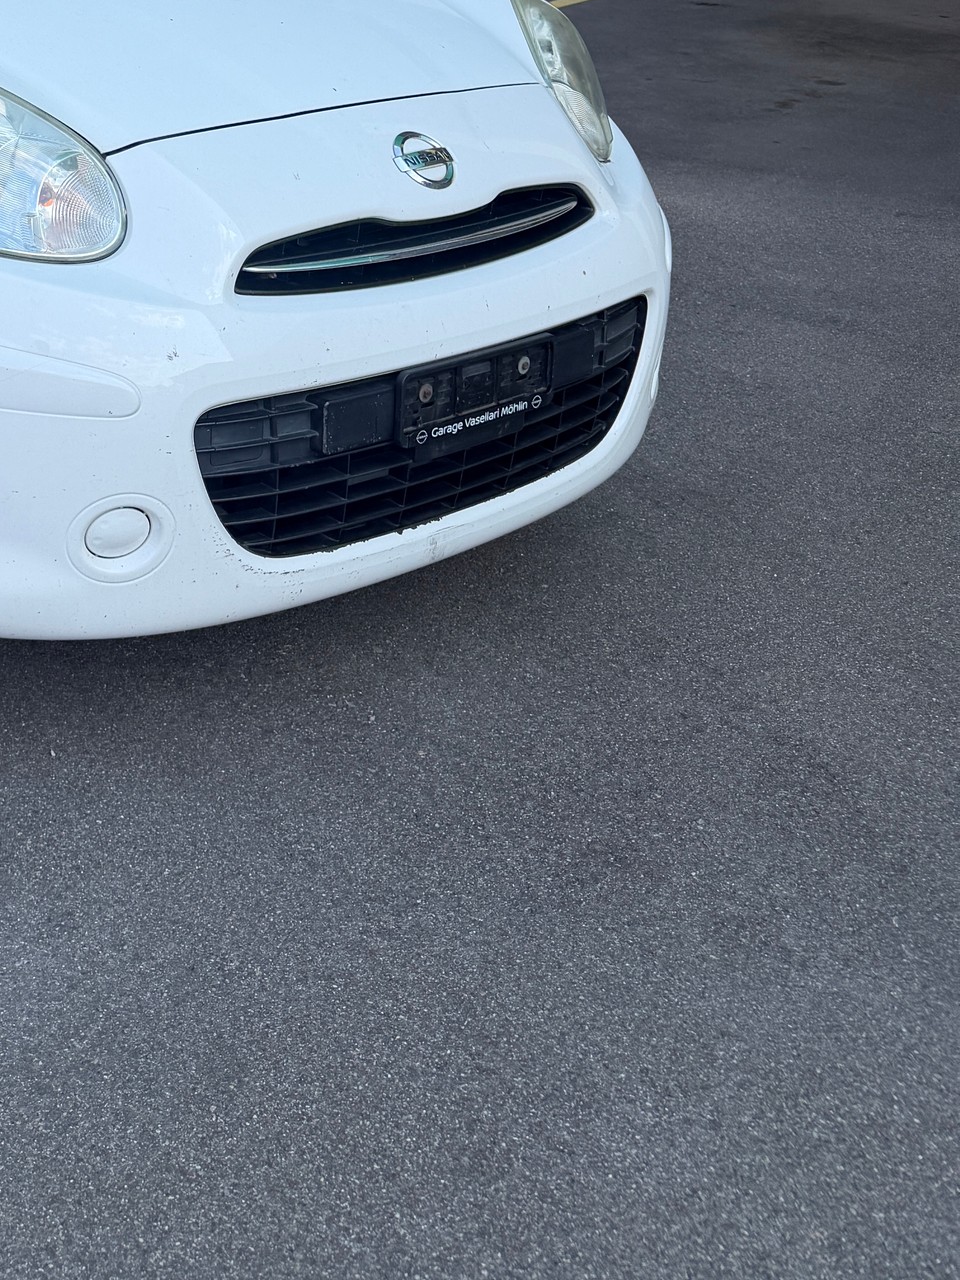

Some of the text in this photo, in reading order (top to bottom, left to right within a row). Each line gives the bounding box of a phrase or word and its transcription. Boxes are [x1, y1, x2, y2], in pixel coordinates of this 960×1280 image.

[404, 151, 449, 167] NISSAN
[431, 401, 528, 437] Garage Vasellari Möhlin
